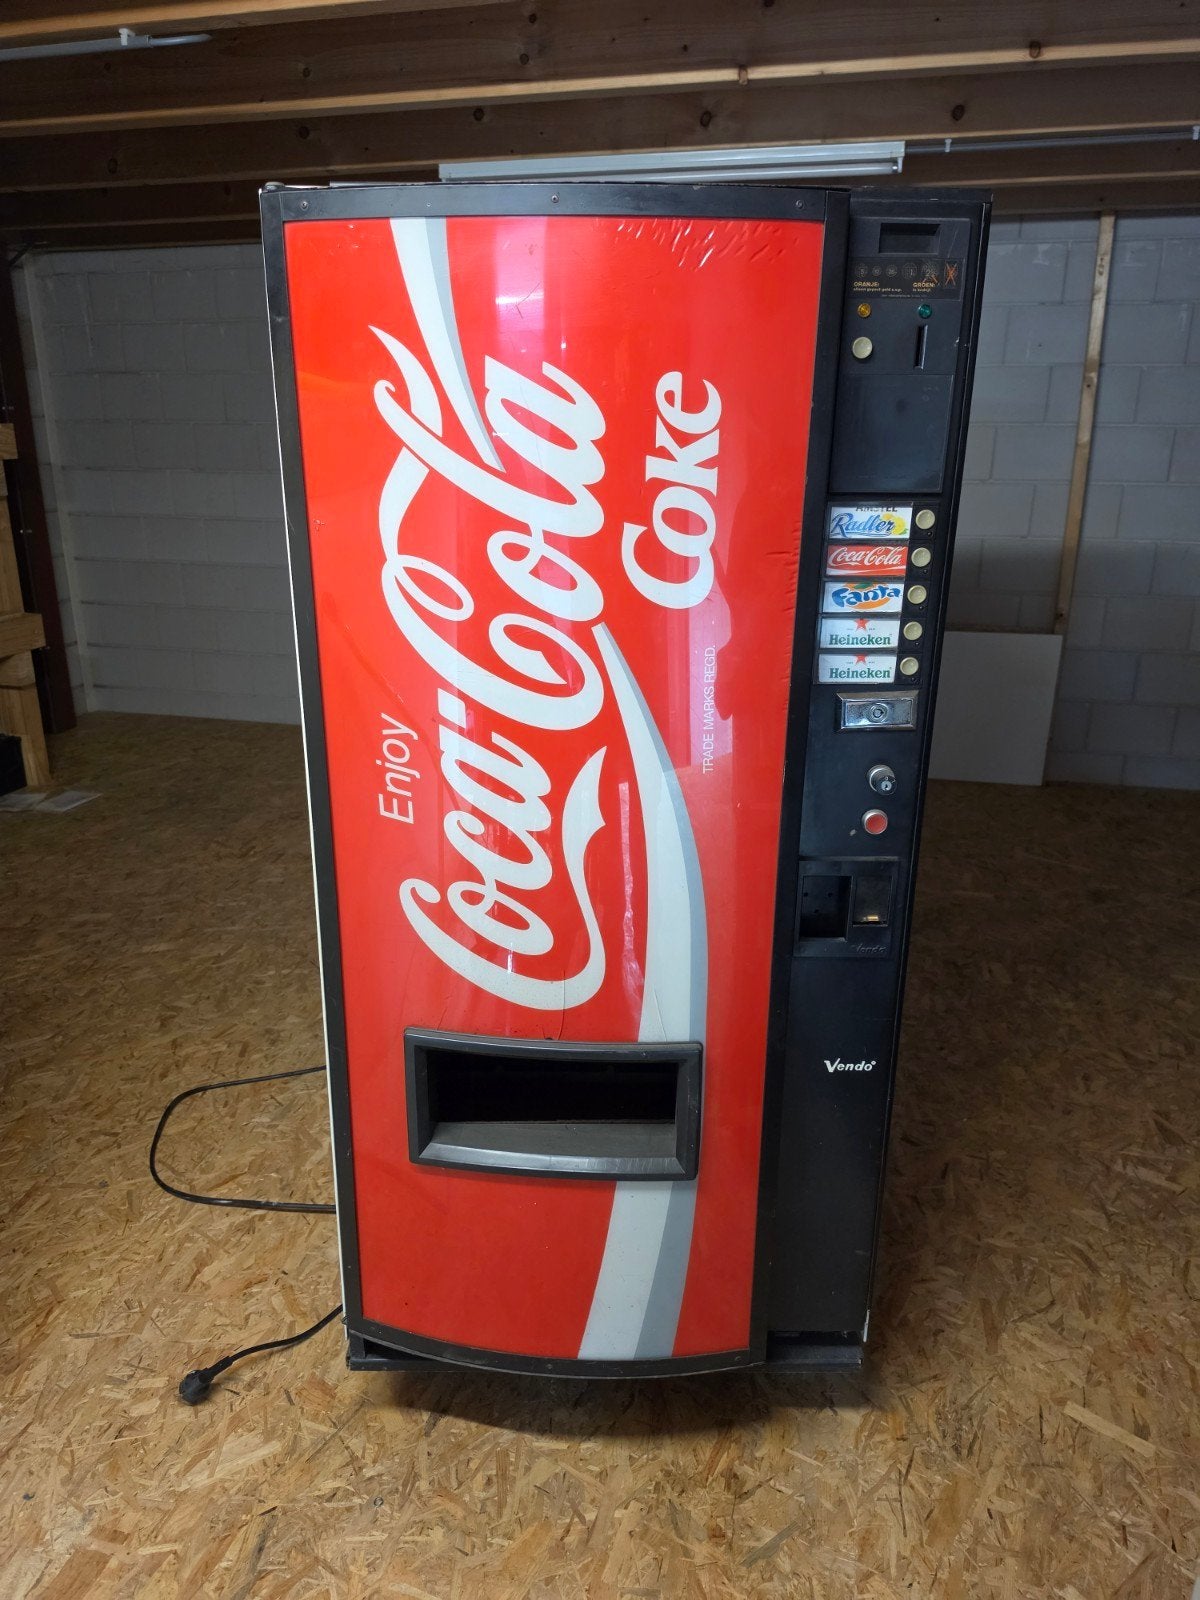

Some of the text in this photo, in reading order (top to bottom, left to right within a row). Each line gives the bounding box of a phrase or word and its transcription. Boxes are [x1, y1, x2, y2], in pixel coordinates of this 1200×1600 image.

[621, 370, 722, 609] Coke
[829, 512, 896, 538] Radler
[827, 546, 907, 566] Coca-Cola
[831, 585, 902, 608] Fanta
[828, 634, 891, 646] Heineken
[368, 325, 608, 1011] Coca-Cola
[829, 667, 891, 679] Heineken
[702, 645, 716, 774] TRADE MARKS REGD.
[375, 712, 421, 824] Enjoy
